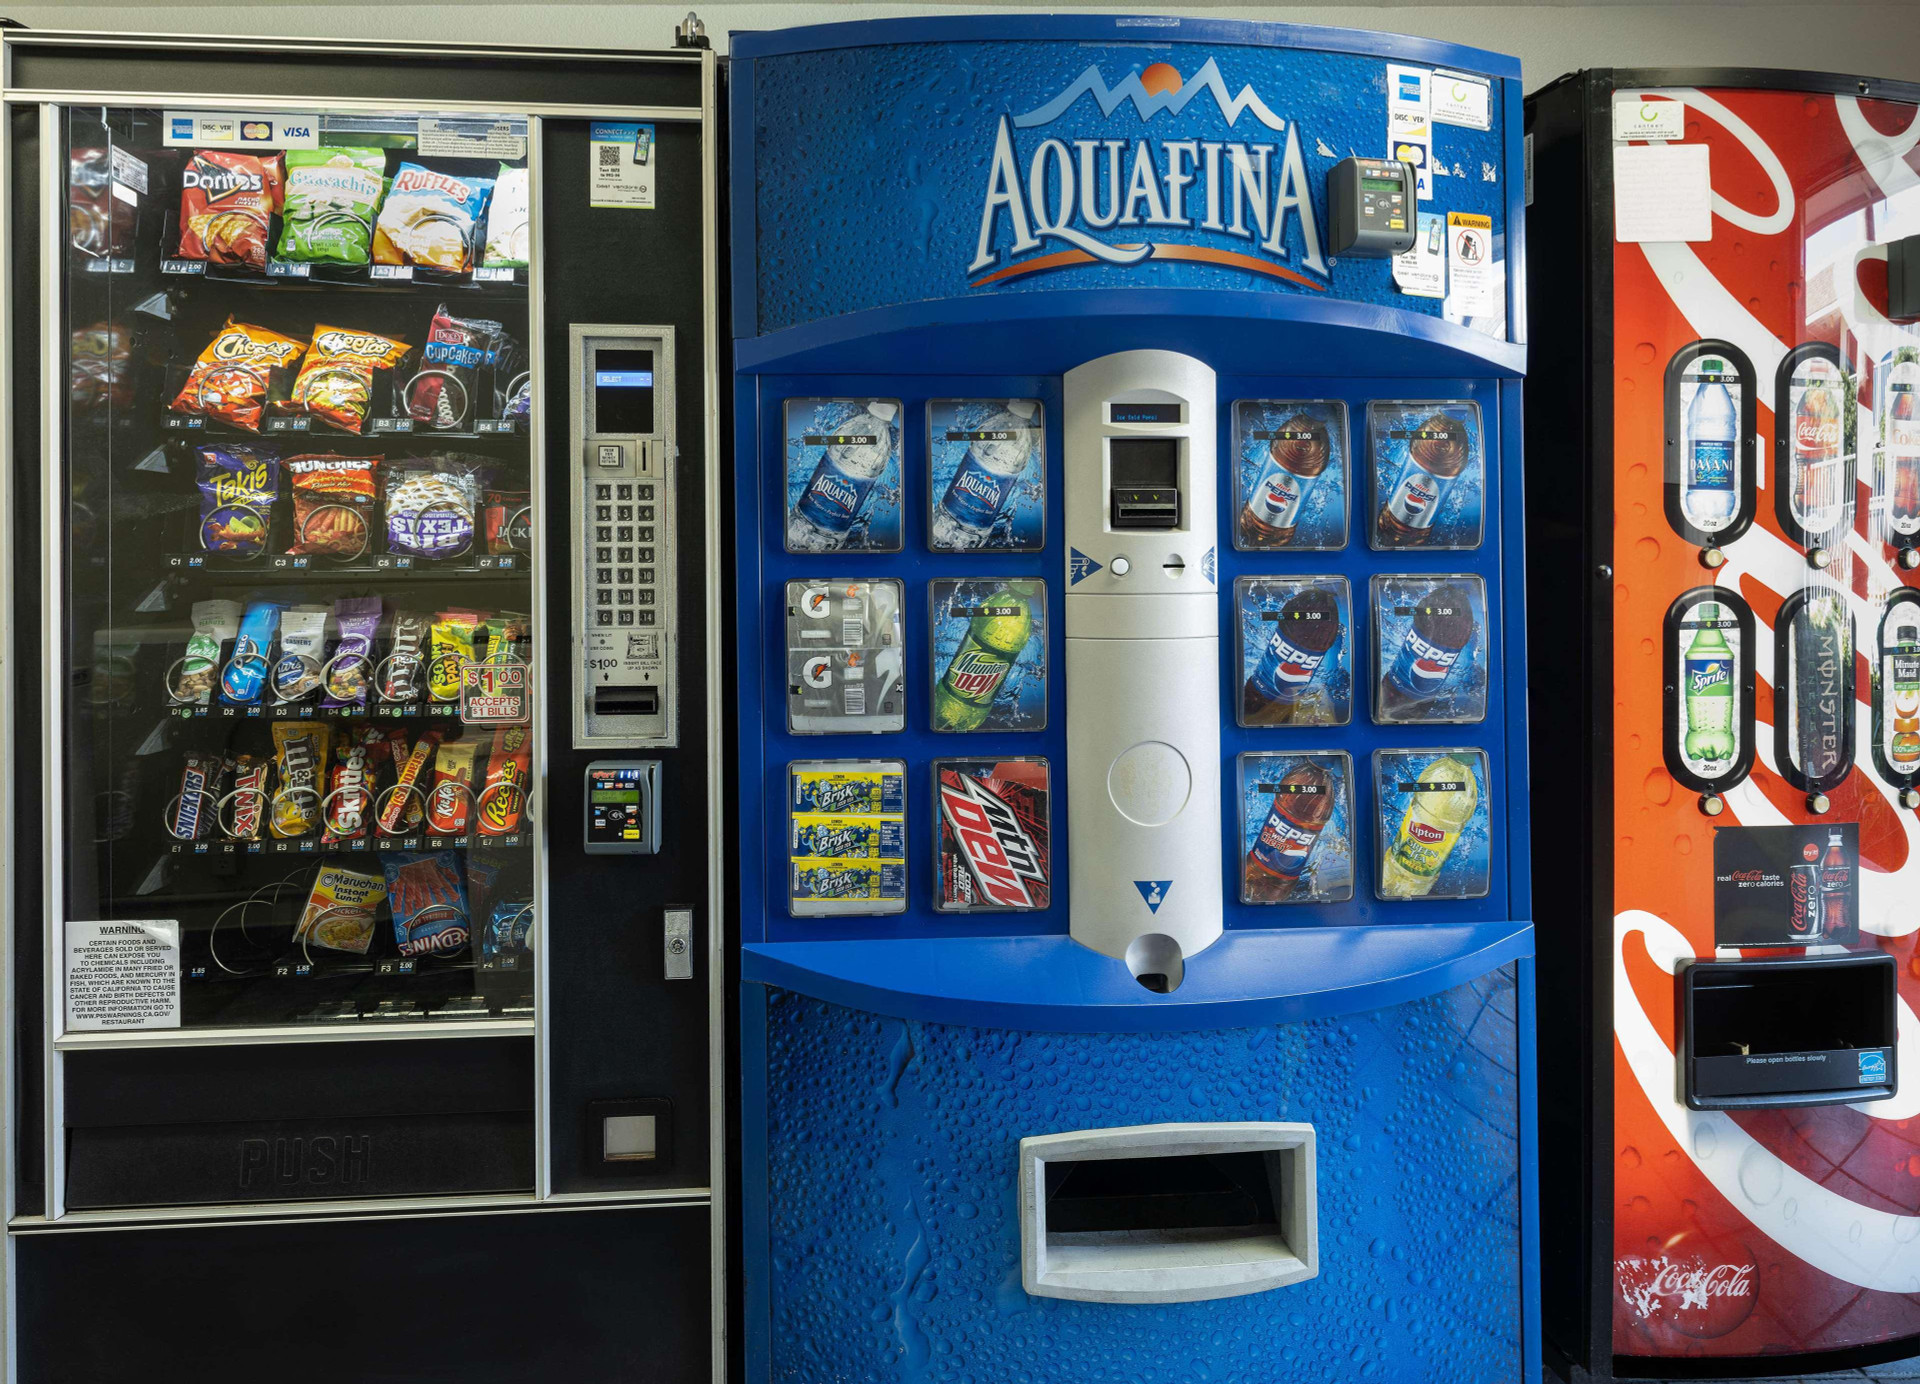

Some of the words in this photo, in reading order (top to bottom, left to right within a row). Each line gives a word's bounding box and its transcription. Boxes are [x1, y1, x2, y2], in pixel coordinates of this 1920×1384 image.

[283, 127, 311, 138] VISA
[183, 171, 262, 191] Doritos
[396, 170, 470, 202] RUFFLES
[967, 115, 1329, 278] AQUAFINA
[1462, 220, 1490, 228] WARNING
[316, 333, 394, 356] Cheetos
[426, 344, 482, 365] CupCakes
[1690, 456, 1733, 474] DASANI
[211, 464, 269, 508] Takis
[811, 473, 858, 513] AQUAFINA
[956, 471, 1002, 509] AQUAFINA
[1265, 481, 1298, 502] PEPSI
[1404, 481, 1436, 502] PEPSI
[391, 517, 468, 534] TEXAS
[1270, 633, 1324, 670] PEPSI
[1406, 629, 1459, 666] PEPSI
[590, 658, 618, 670] $1.00
[1694, 670, 1728, 690] Sprite
[470, 697, 520, 706] ACCEPTS
[488, 707, 518, 716] BILLS
[1817, 635, 1838, 770] MONSTER
[336, 744, 366, 828] Skittles
[486, 758, 516, 826] Reese's
[822, 784, 854, 808] Brisk
[174, 770, 206, 839] SNICKERS
[234, 768, 261, 837] TWIX
[819, 829, 852, 852] Brisk
[1269, 814, 1316, 846] PEPSI
[1410, 822, 1442, 840] Lipton
[1407, 836, 1439, 858] GREEN
[334, 874, 384, 892] Maruchan
[820, 871, 852, 893] Brisk
[1717, 874, 1731, 882] real
[333, 885, 369, 897] Instant
[335, 893, 363, 903] Lunch
[1808, 886, 1816, 918] zero
[1784, 1055, 1806, 1063] bottles
[1807, 1054, 1827, 1063] slowly
[240, 1135, 370, 1188] PUSH
